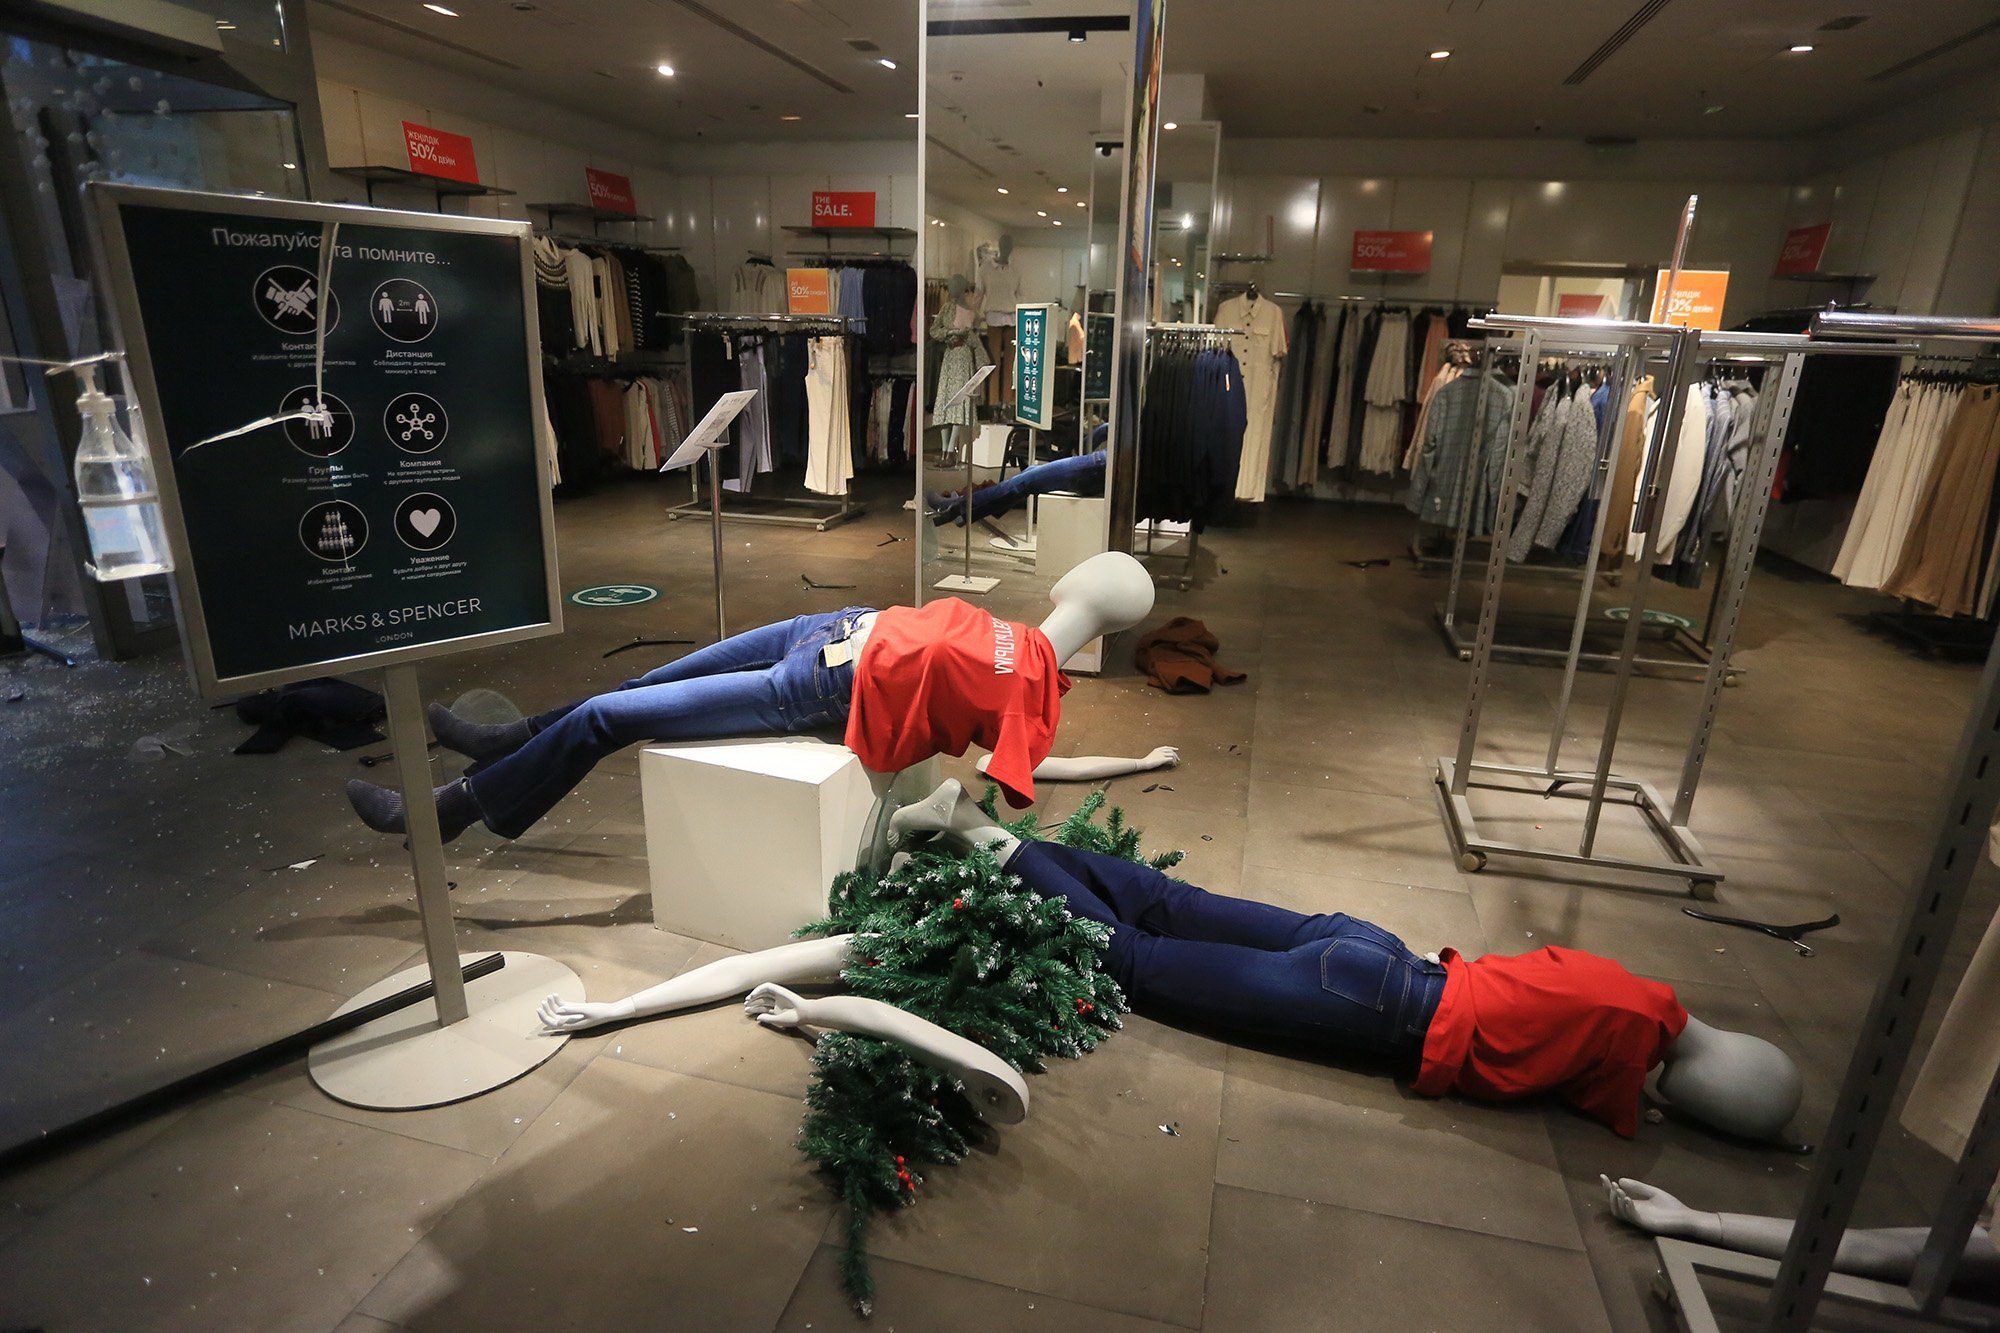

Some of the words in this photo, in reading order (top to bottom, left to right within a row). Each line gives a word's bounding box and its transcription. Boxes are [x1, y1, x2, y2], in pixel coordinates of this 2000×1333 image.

[410, 140, 438, 162] 50%
[815, 205, 852, 216] SALE.
[359, 247, 451, 265] помните...
[1357, 244, 1386, 258] 50%
[791, 286, 810, 296] 50%
[385, 350, 433, 359] Дистанция
[399, 460, 442, 468] Компания
[409, 554, 450, 565] Уважение
[289, 614, 367, 640] MARKS
[371, 613, 385, 628] &
[388, 598, 482, 626] SPENCER
[375, 631, 413, 643] LONDON
